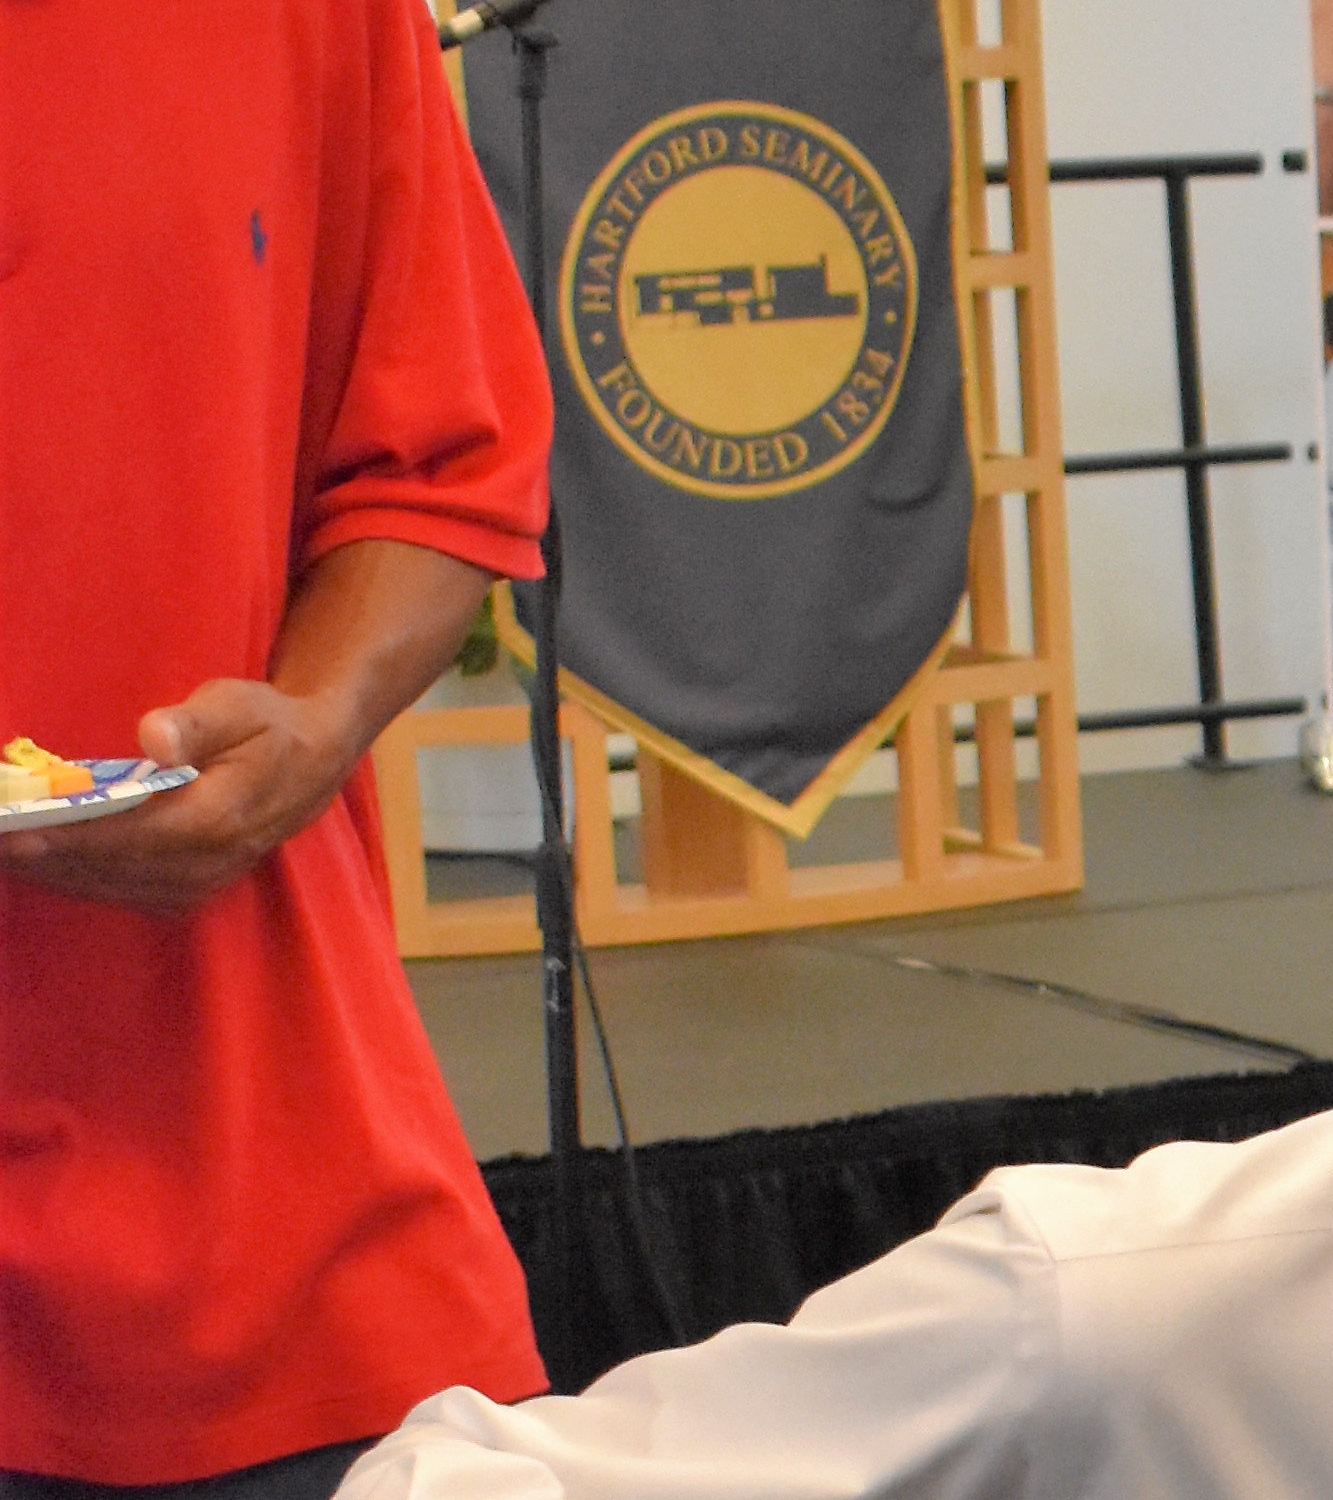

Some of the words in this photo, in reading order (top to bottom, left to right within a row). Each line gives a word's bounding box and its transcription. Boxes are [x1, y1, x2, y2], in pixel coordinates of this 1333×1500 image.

[579, 127, 728, 312] HARTFORD
[740, 125, 901, 289] SEMINARY
[599, 359, 809, 476] FOUNDED
[822, 347, 895, 441] 1834
